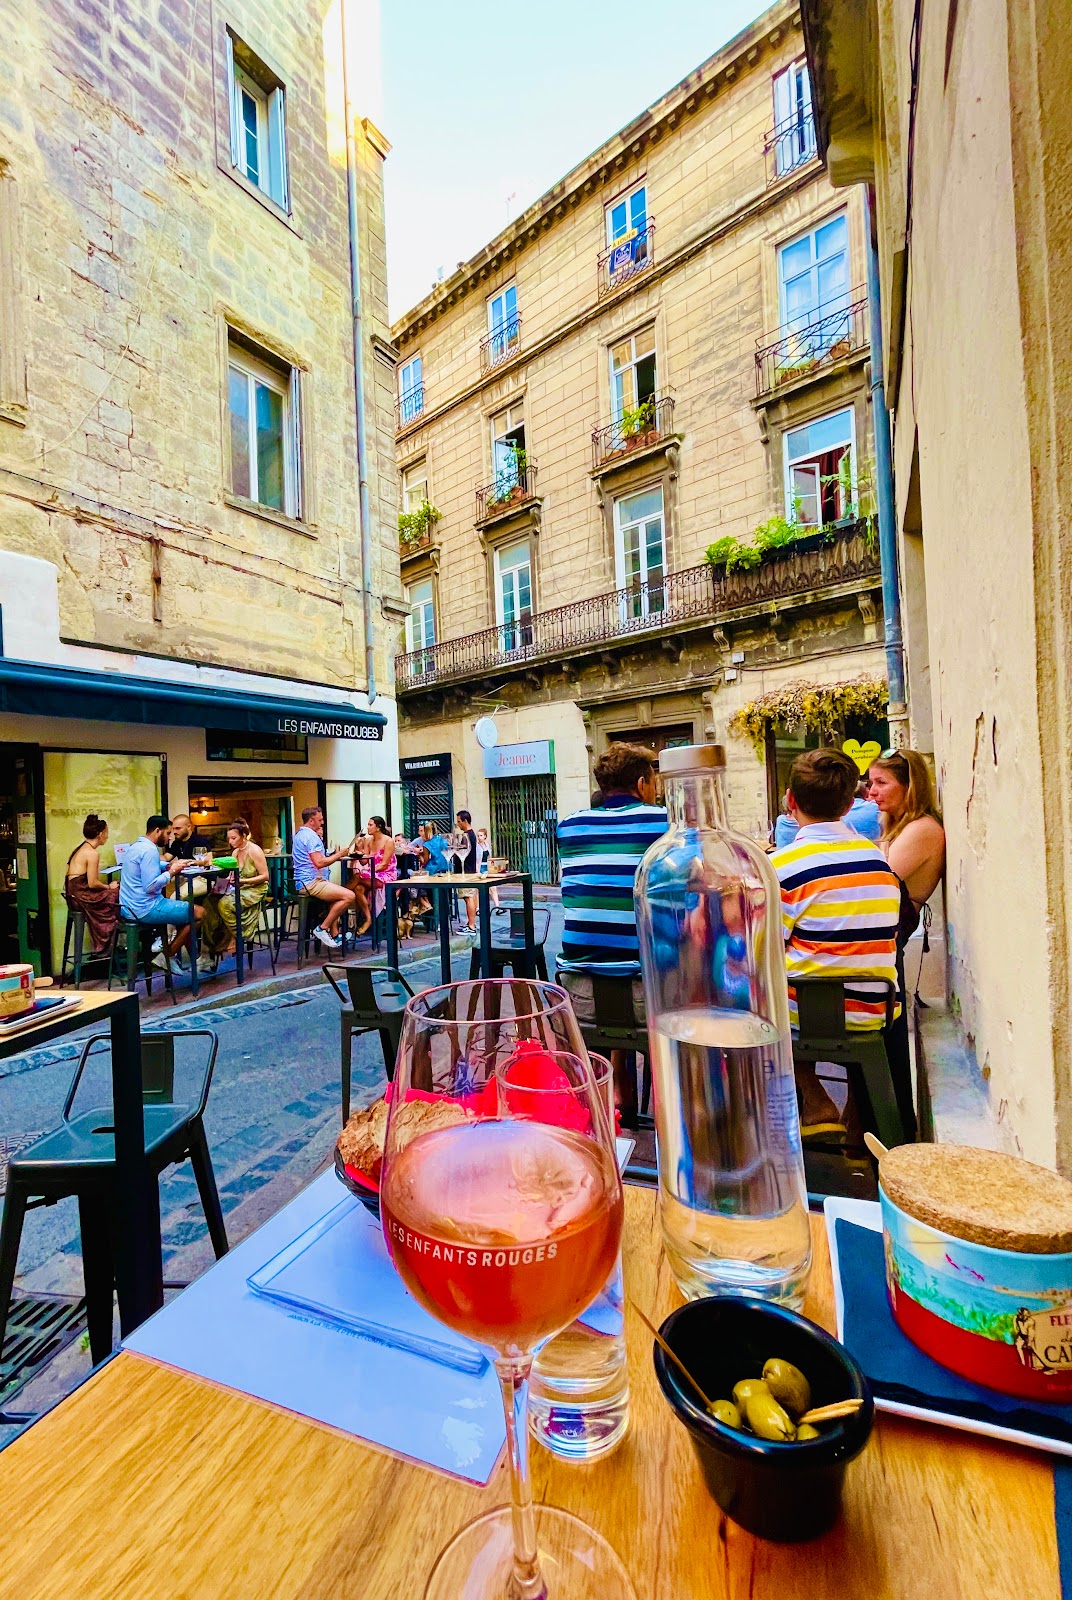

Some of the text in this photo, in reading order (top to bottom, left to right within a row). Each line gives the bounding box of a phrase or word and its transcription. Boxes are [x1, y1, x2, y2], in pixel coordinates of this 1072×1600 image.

[278, 719, 379, 739] LES ENFANTS ROUGES
[404, 759, 441, 770] WARHAMMER
[494, 752, 536, 767] Jeanne
[1044, 1345, 1072, 1363] CA
